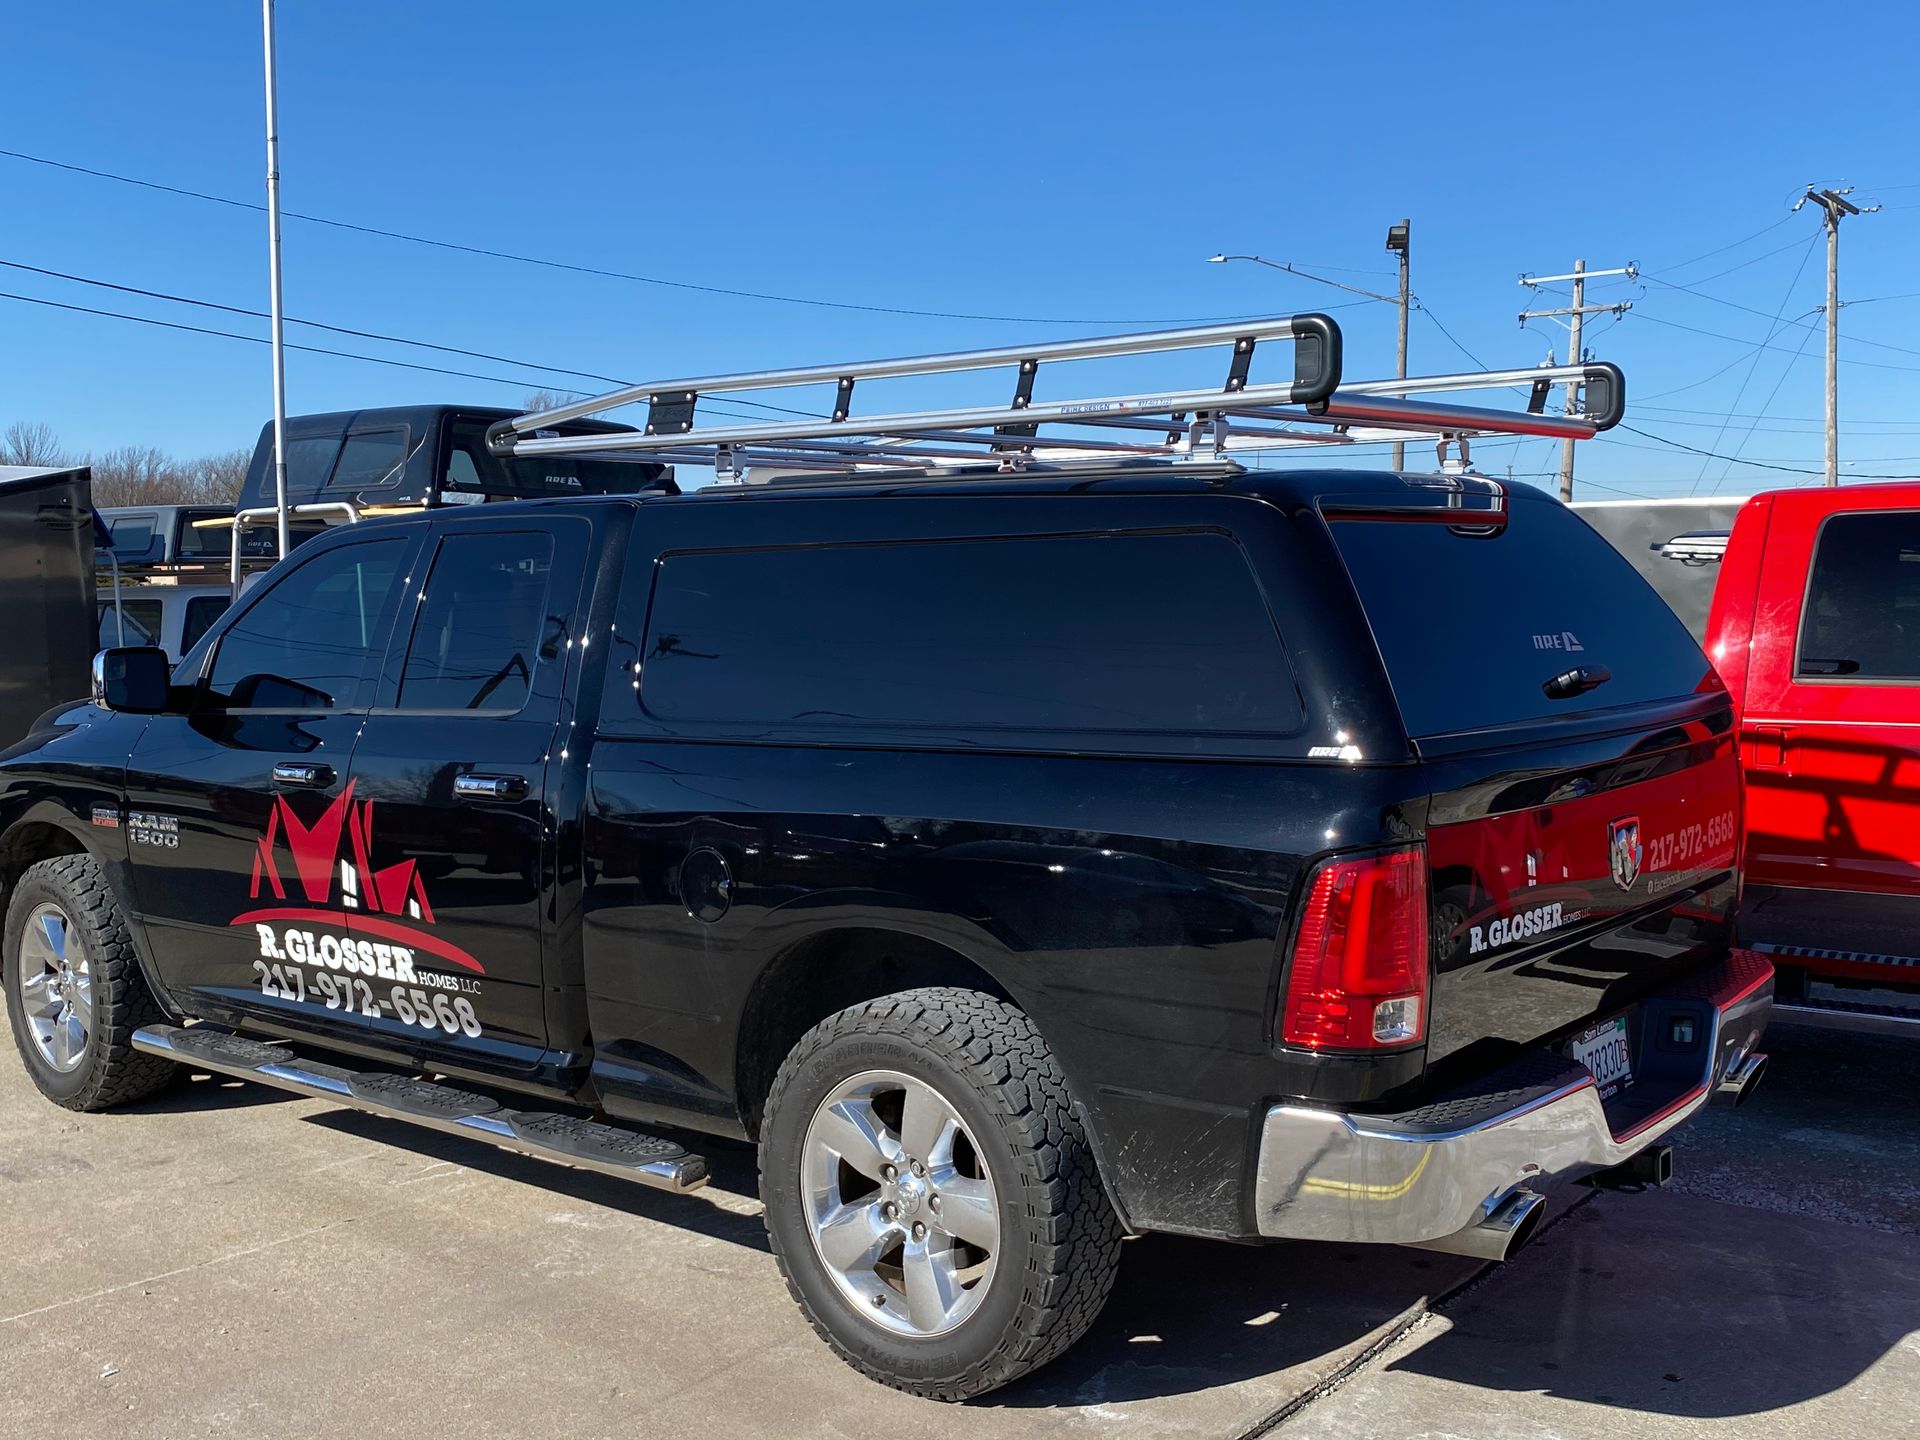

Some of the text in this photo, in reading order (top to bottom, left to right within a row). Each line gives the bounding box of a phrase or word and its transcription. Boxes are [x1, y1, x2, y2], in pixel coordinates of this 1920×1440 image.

[1084, 402, 1110, 413] DESIGN
[128, 811, 179, 832] RAM
[129, 829, 179, 849] 1500
[1650, 810, 1734, 872] 217-972-6568
[418, 971, 459, 991] HOMES
[460, 978, 482, 995] LLC
[252, 959, 482, 1039] 217-972-6568
[1581, 1039, 1628, 1082] 78330B
